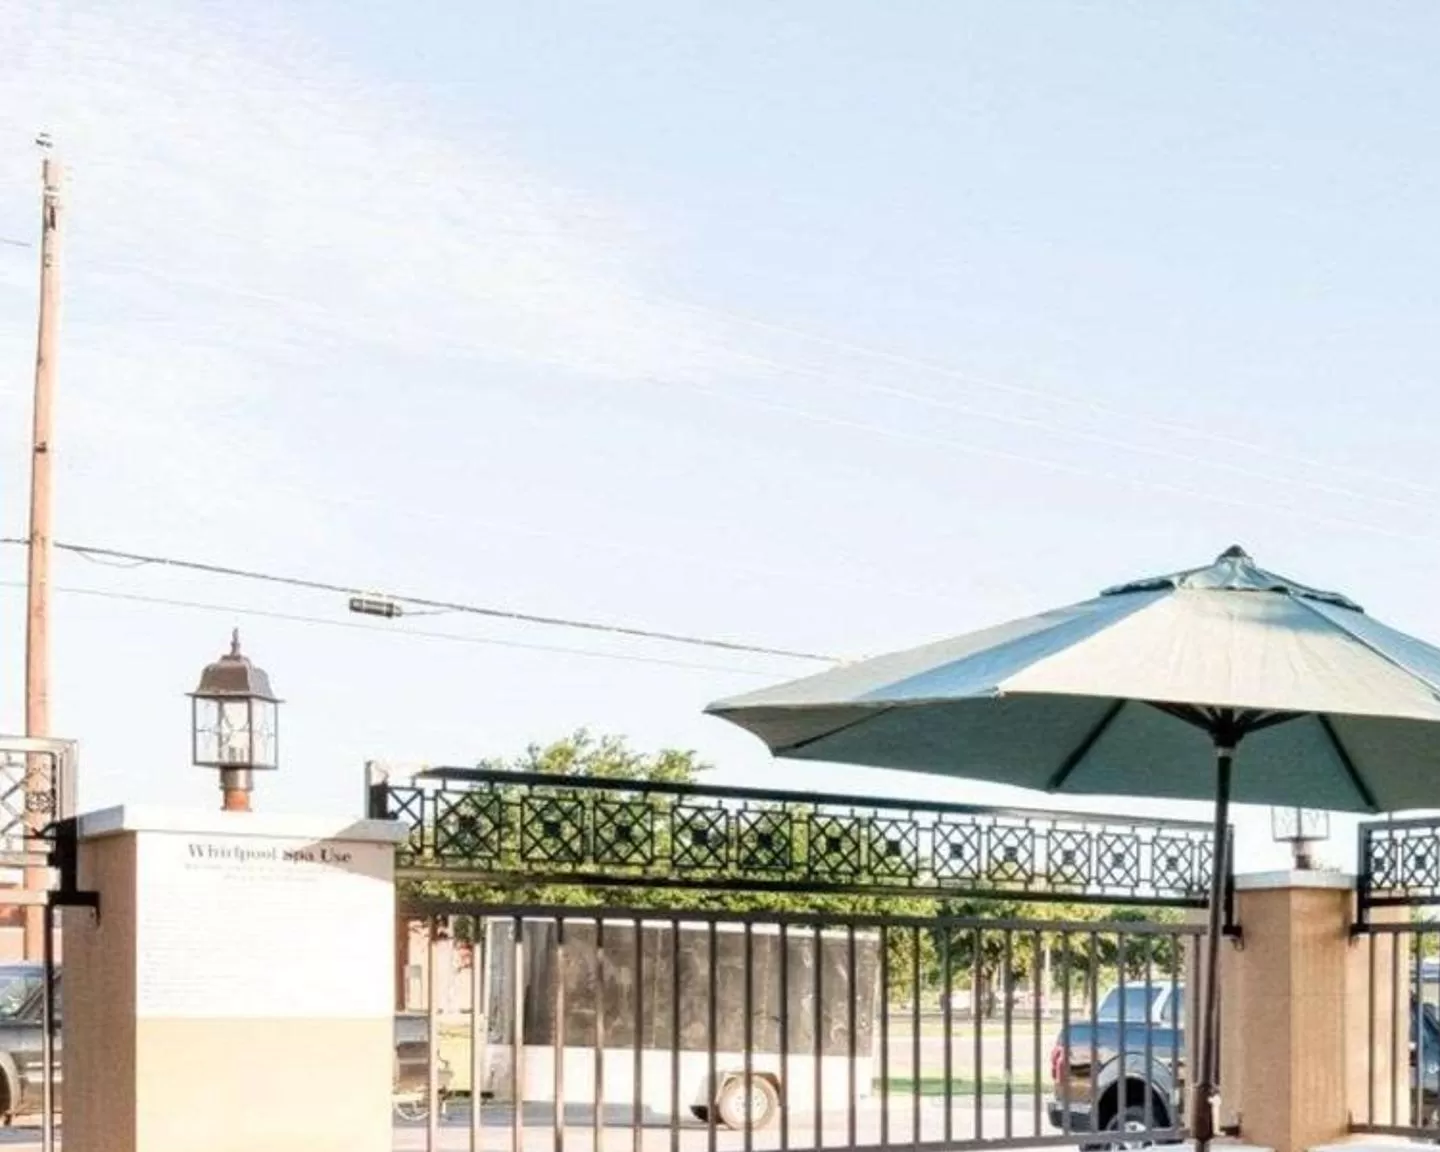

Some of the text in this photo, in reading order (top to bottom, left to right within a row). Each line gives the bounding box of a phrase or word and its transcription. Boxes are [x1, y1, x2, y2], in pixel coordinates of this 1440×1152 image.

[187, 843, 352, 864] Whirlpool spa Use
